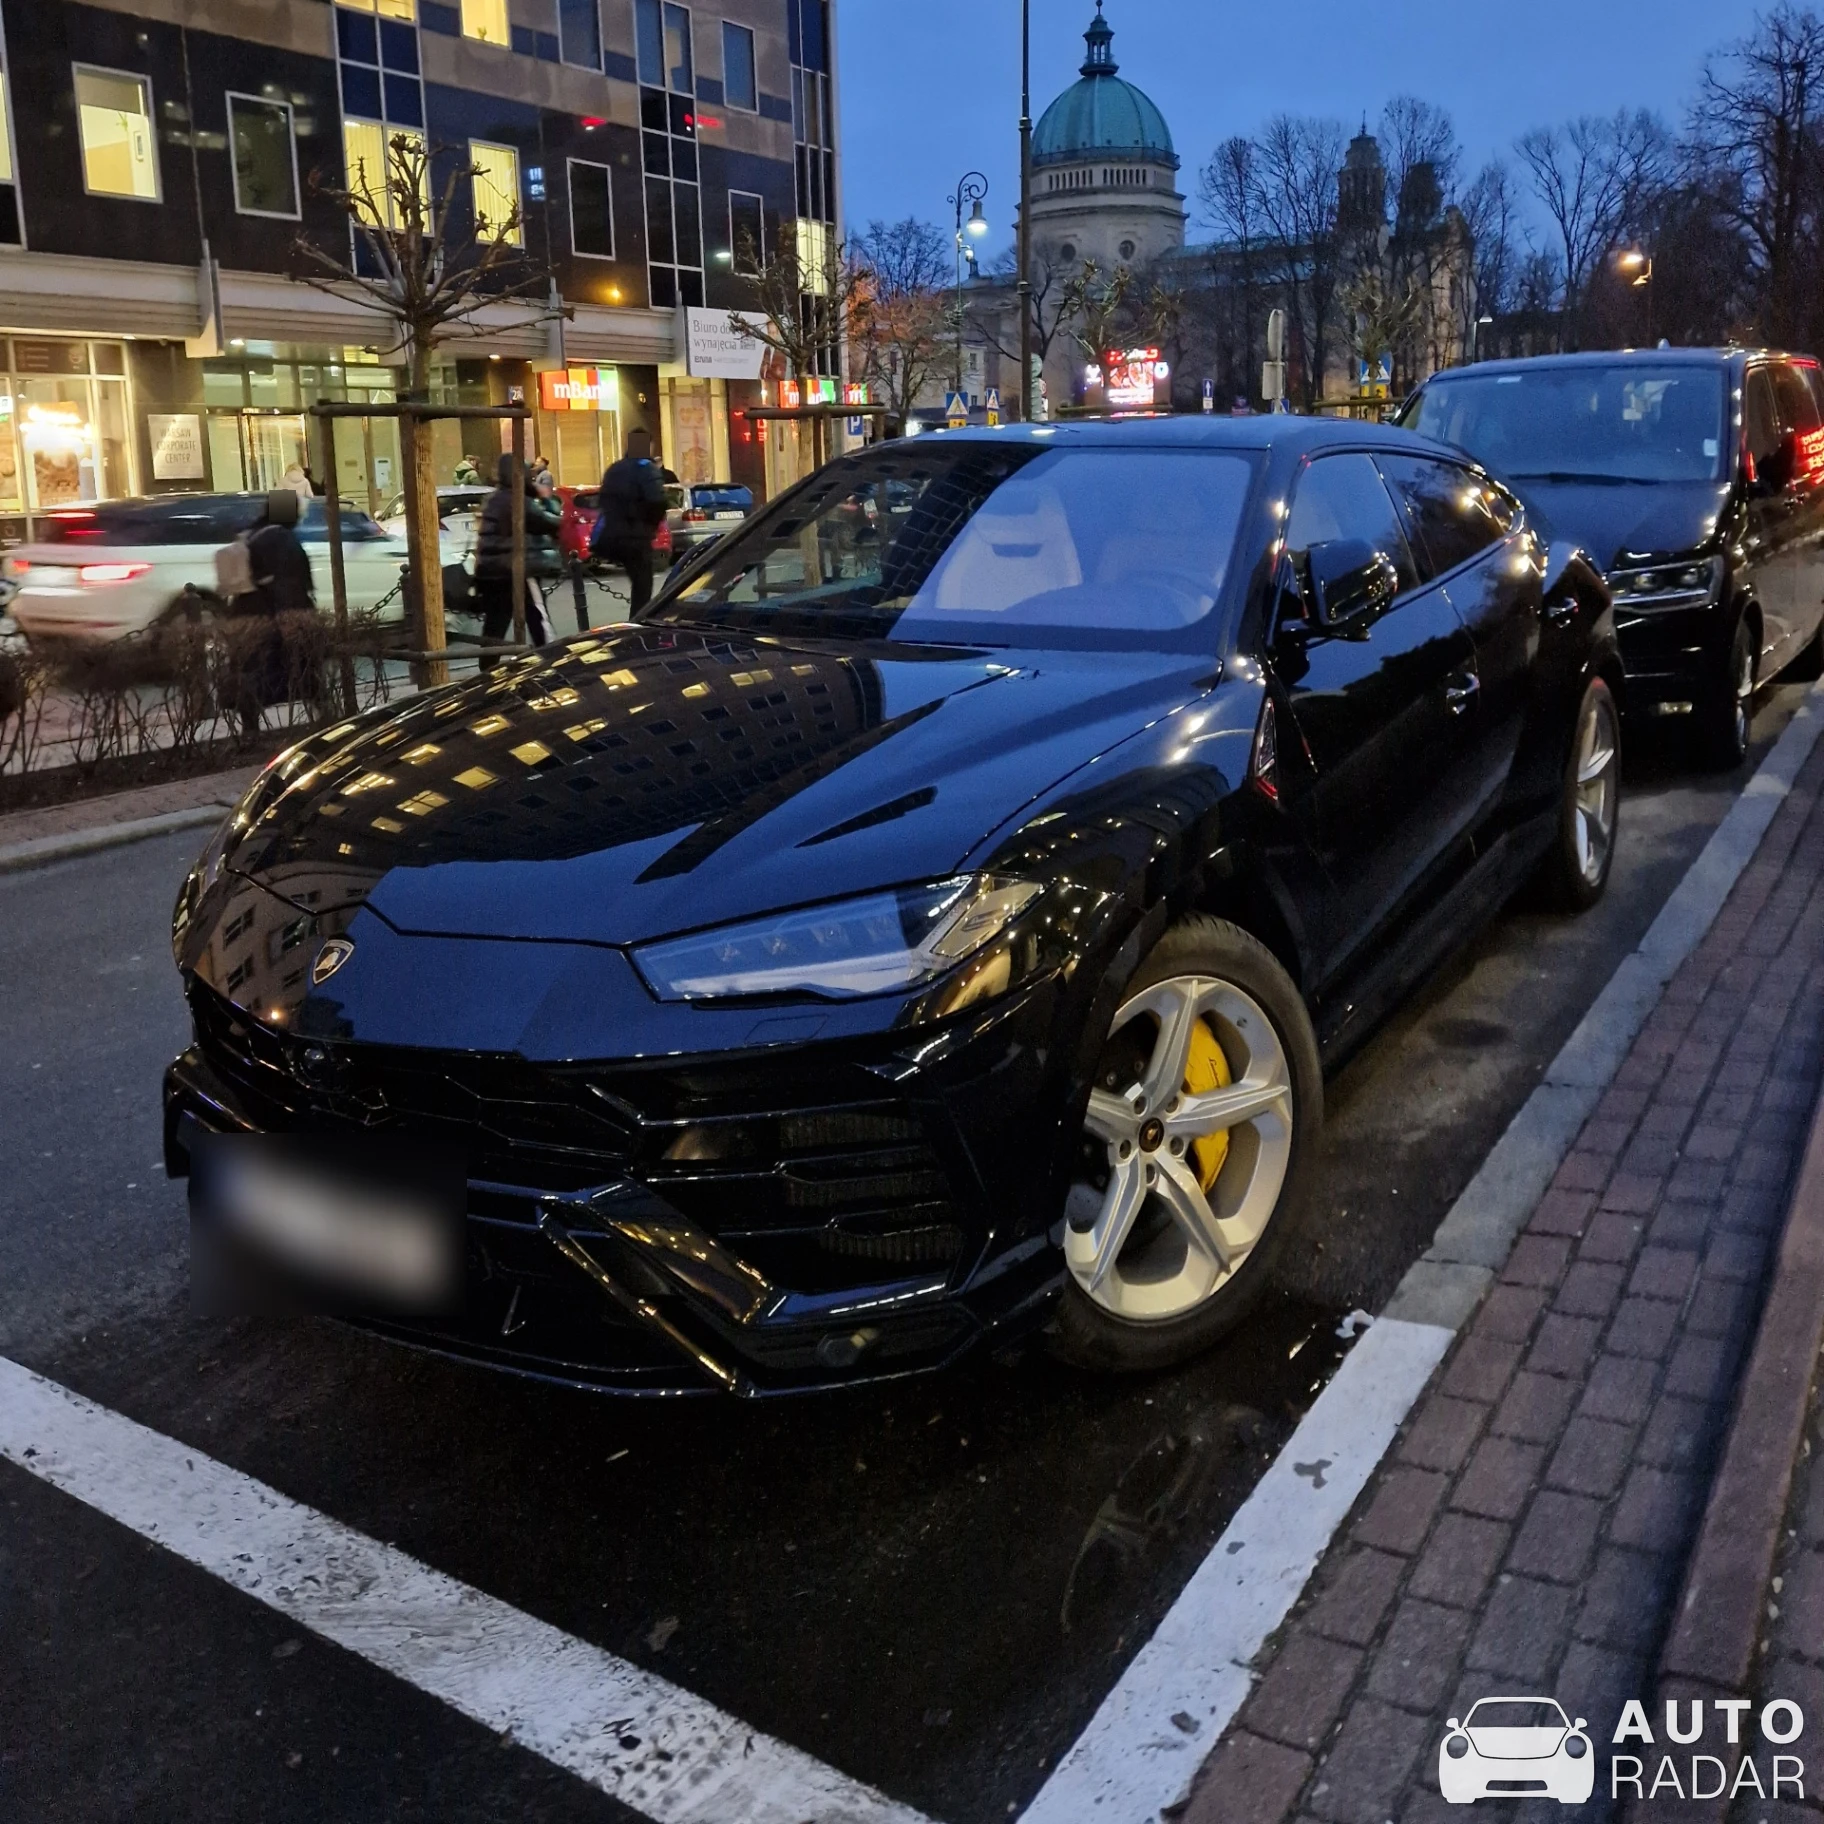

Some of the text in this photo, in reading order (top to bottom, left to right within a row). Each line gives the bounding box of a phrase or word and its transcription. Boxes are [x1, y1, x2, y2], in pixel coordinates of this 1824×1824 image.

[693, 320, 718, 334] Biuro
[693, 339, 737, 352] wynajęcia
[156, 440, 196, 451] CORPORATE
[165, 453, 191, 464] CENTER
